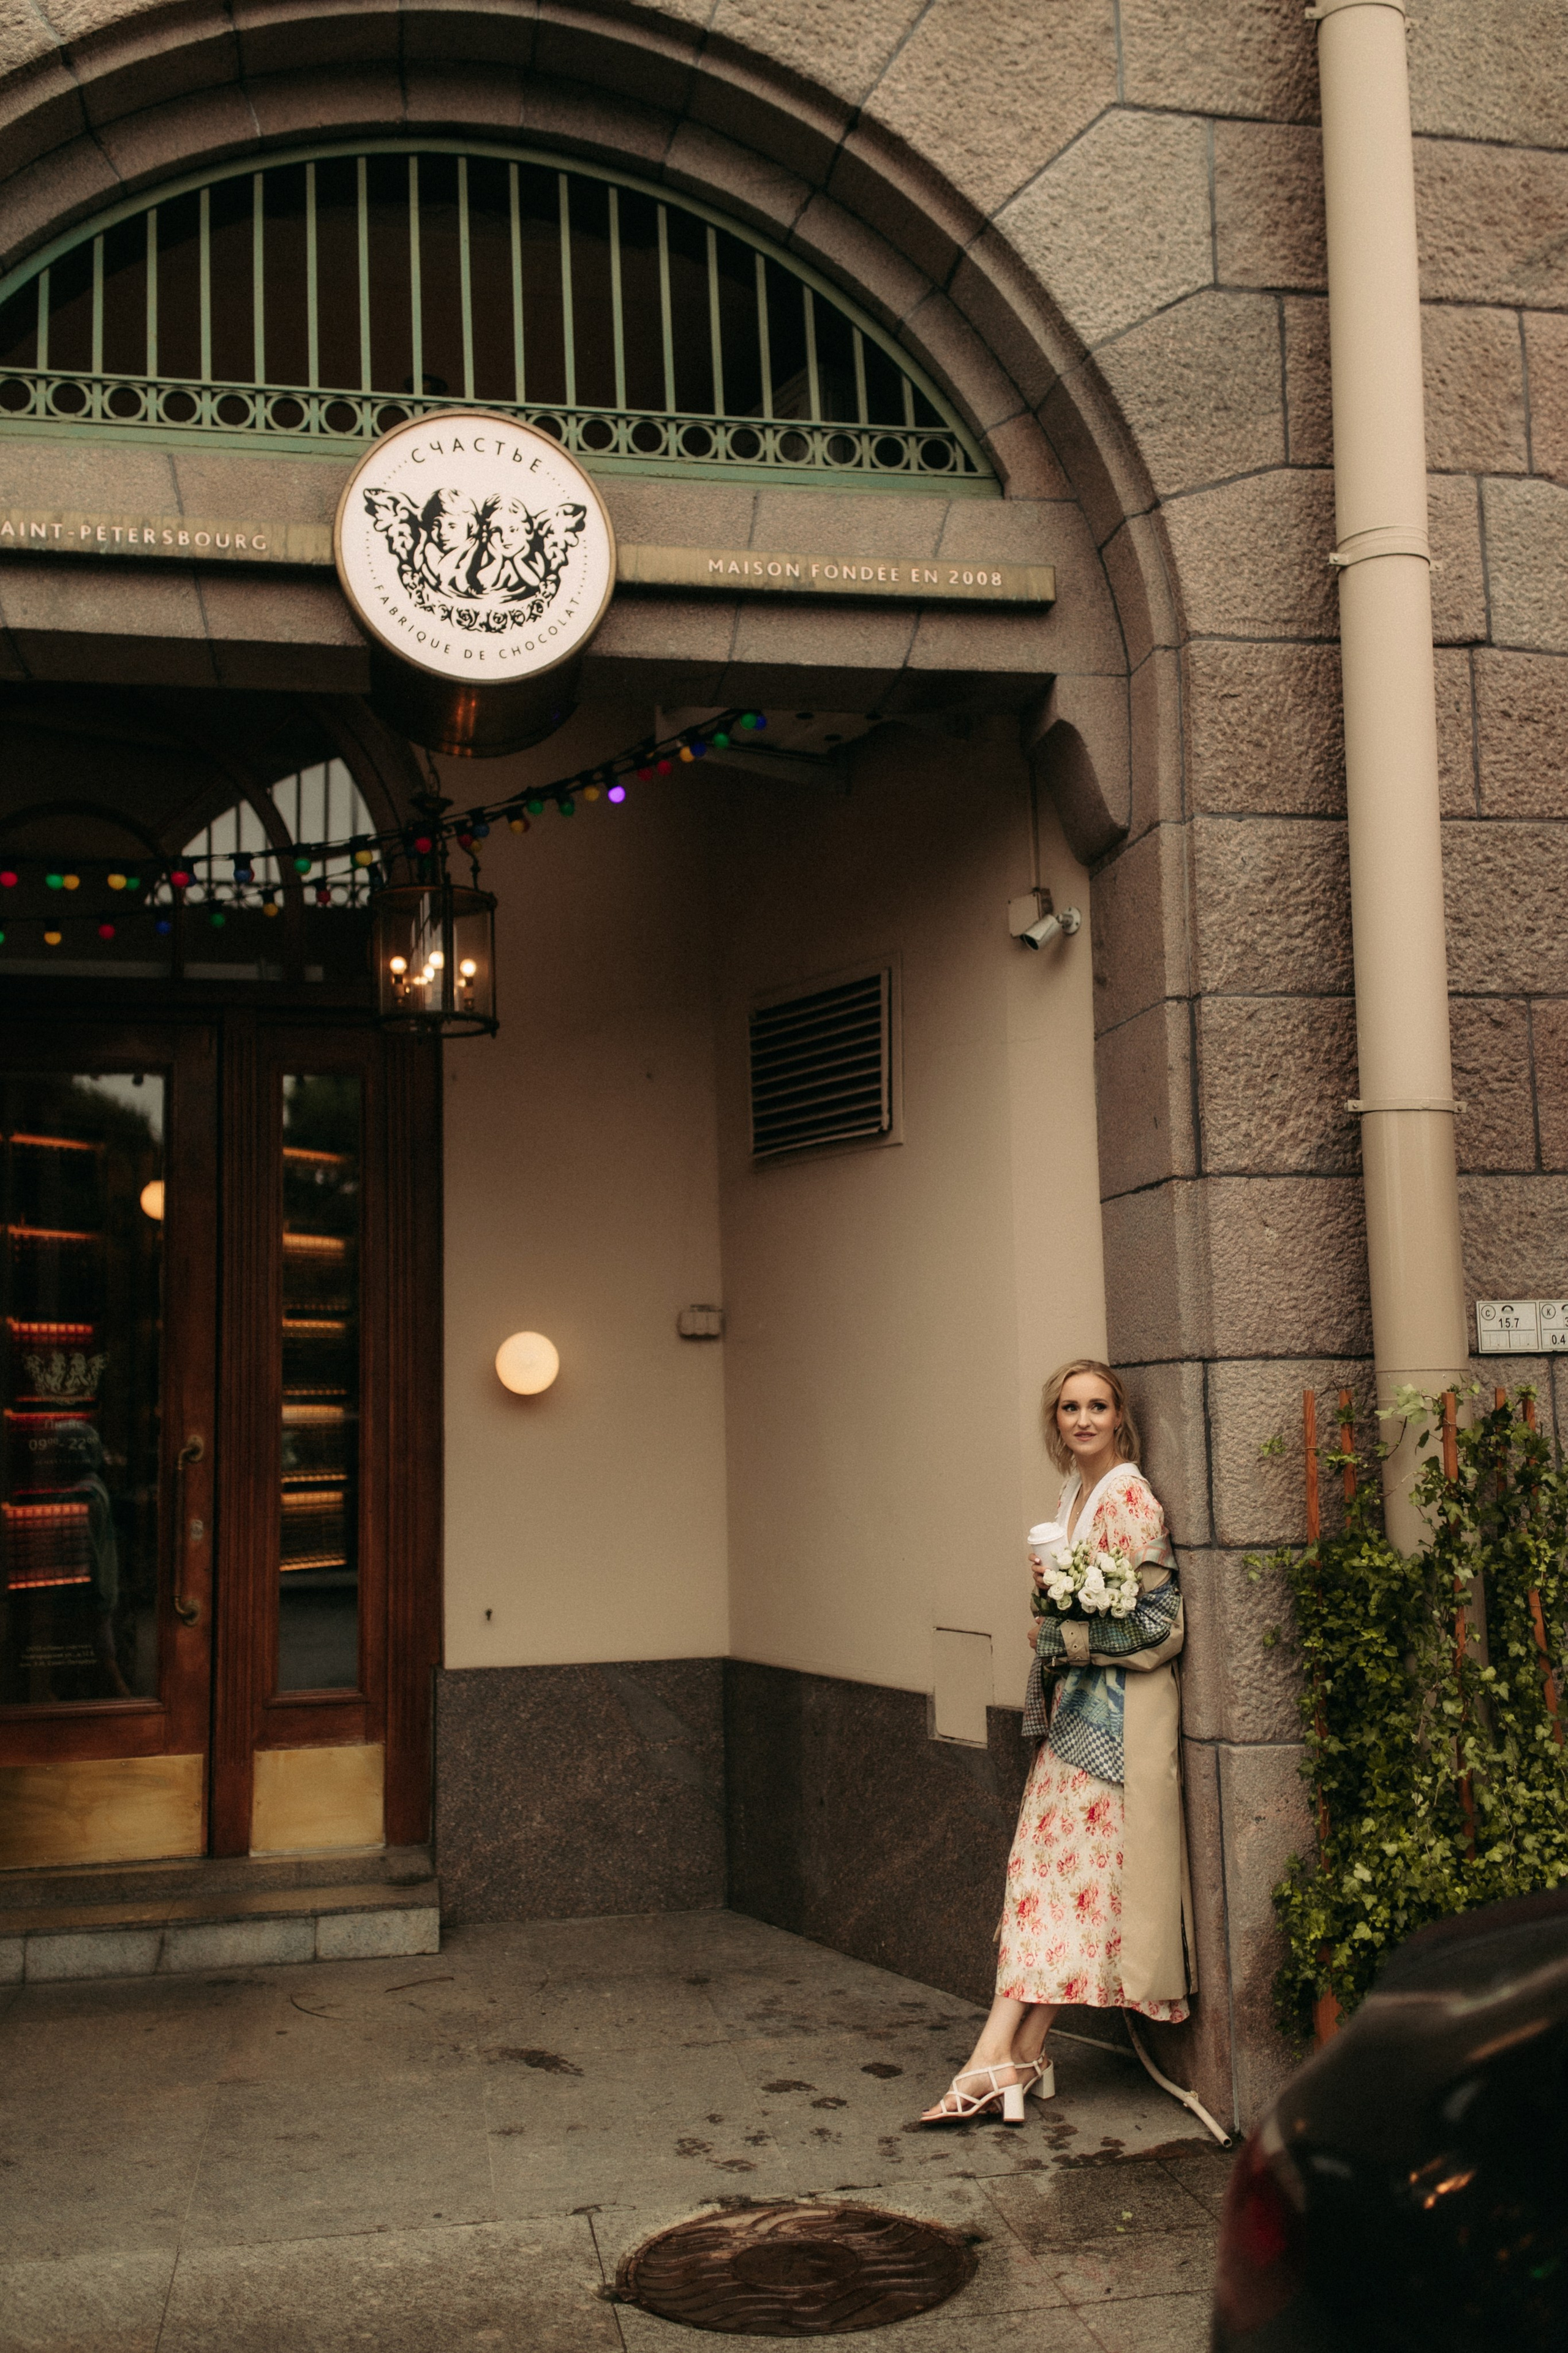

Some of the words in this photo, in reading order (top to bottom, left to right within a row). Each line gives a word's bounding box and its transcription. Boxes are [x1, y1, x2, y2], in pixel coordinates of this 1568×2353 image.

[411, 437, 542, 474] СЧАСТЬЕ
[708, 559, 800, 577] MAISON
[812, 562, 899, 582] FONDÉE
[911, 568, 938, 584] EN
[949, 570, 1002, 586] 2008
[374, 584, 451, 655] FABRIQUE
[464, 649, 485, 661] DE
[499, 597, 580, 660] CHOCOLAT
[1498, 1318, 1519, 1328] 15.7
[1551, 1334, 1566, 1345] 0.4
